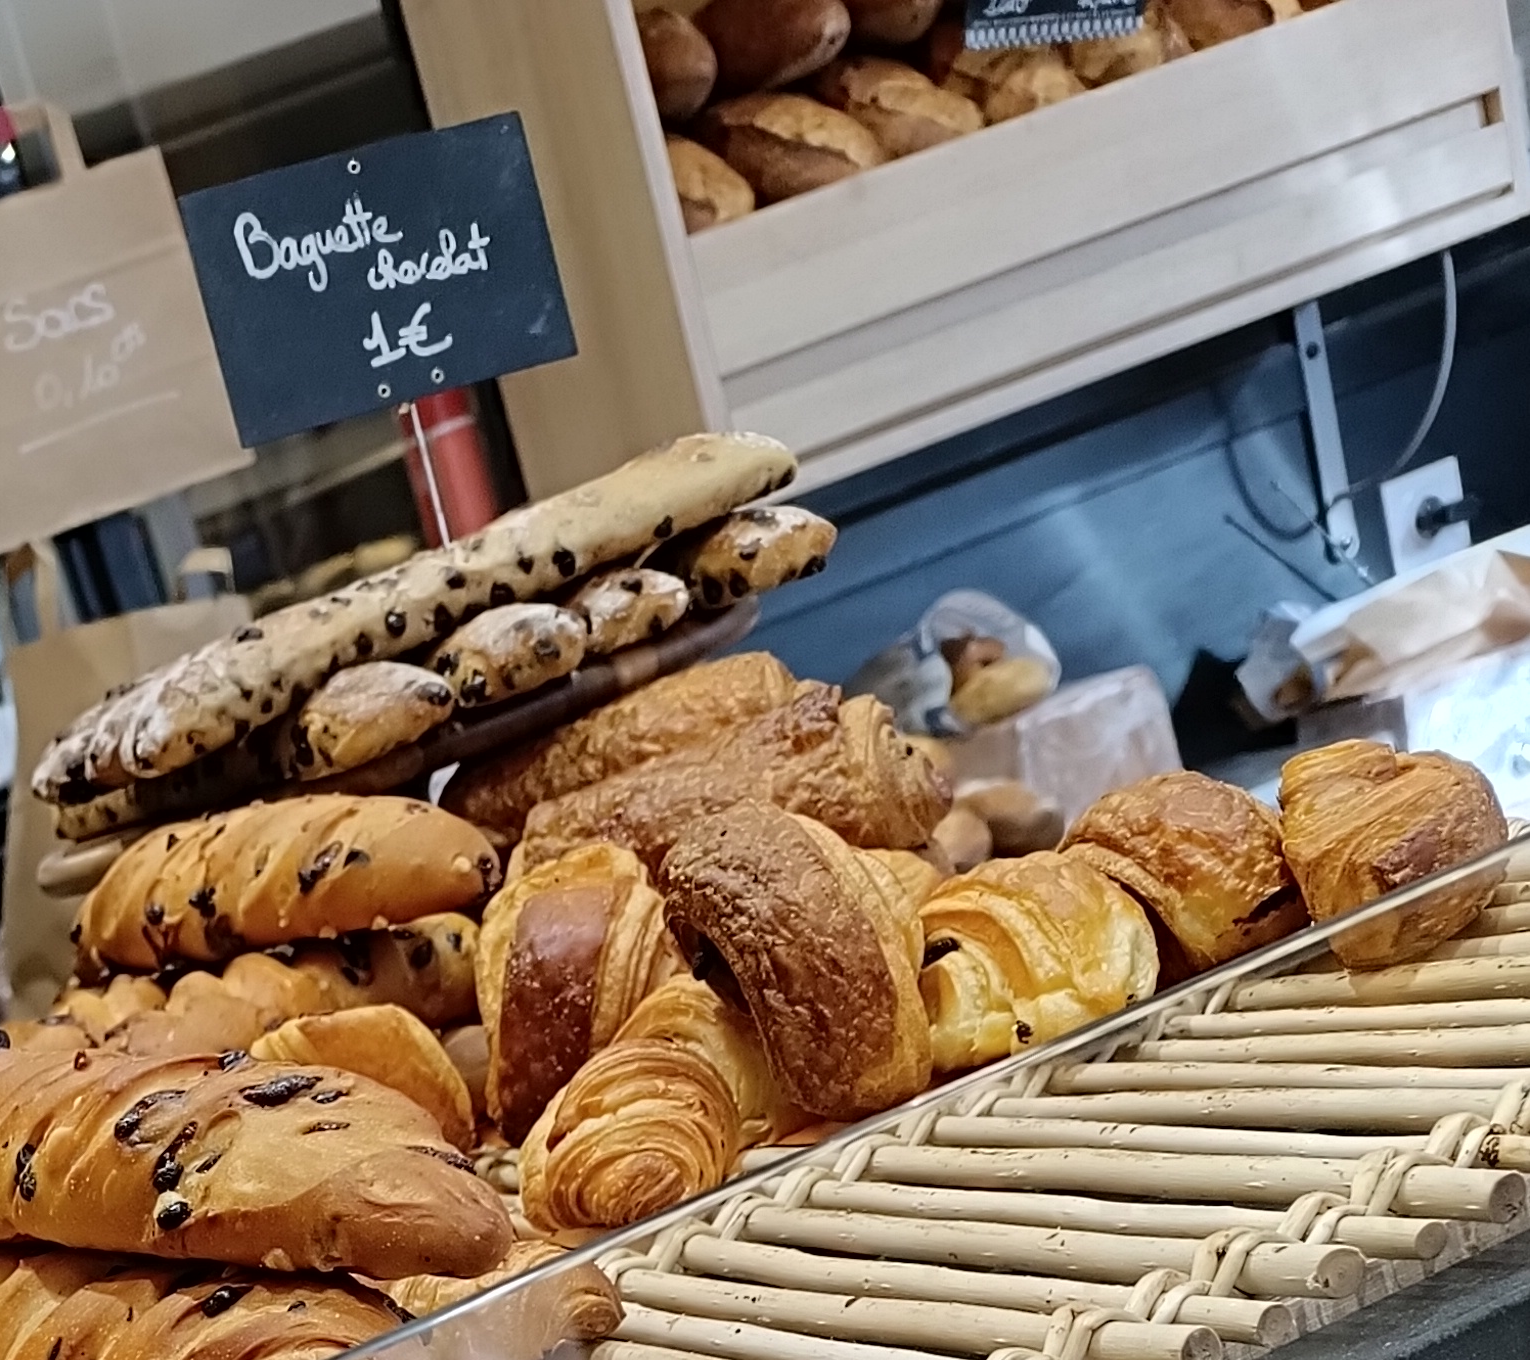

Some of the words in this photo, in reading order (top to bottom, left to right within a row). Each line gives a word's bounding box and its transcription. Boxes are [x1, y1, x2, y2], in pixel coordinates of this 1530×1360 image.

[234, 190, 404, 291] Baguette
[367, 221, 490, 290] chocolat
[3, 282, 116, 352] Sacs
[363, 302, 453, 367] 1€
